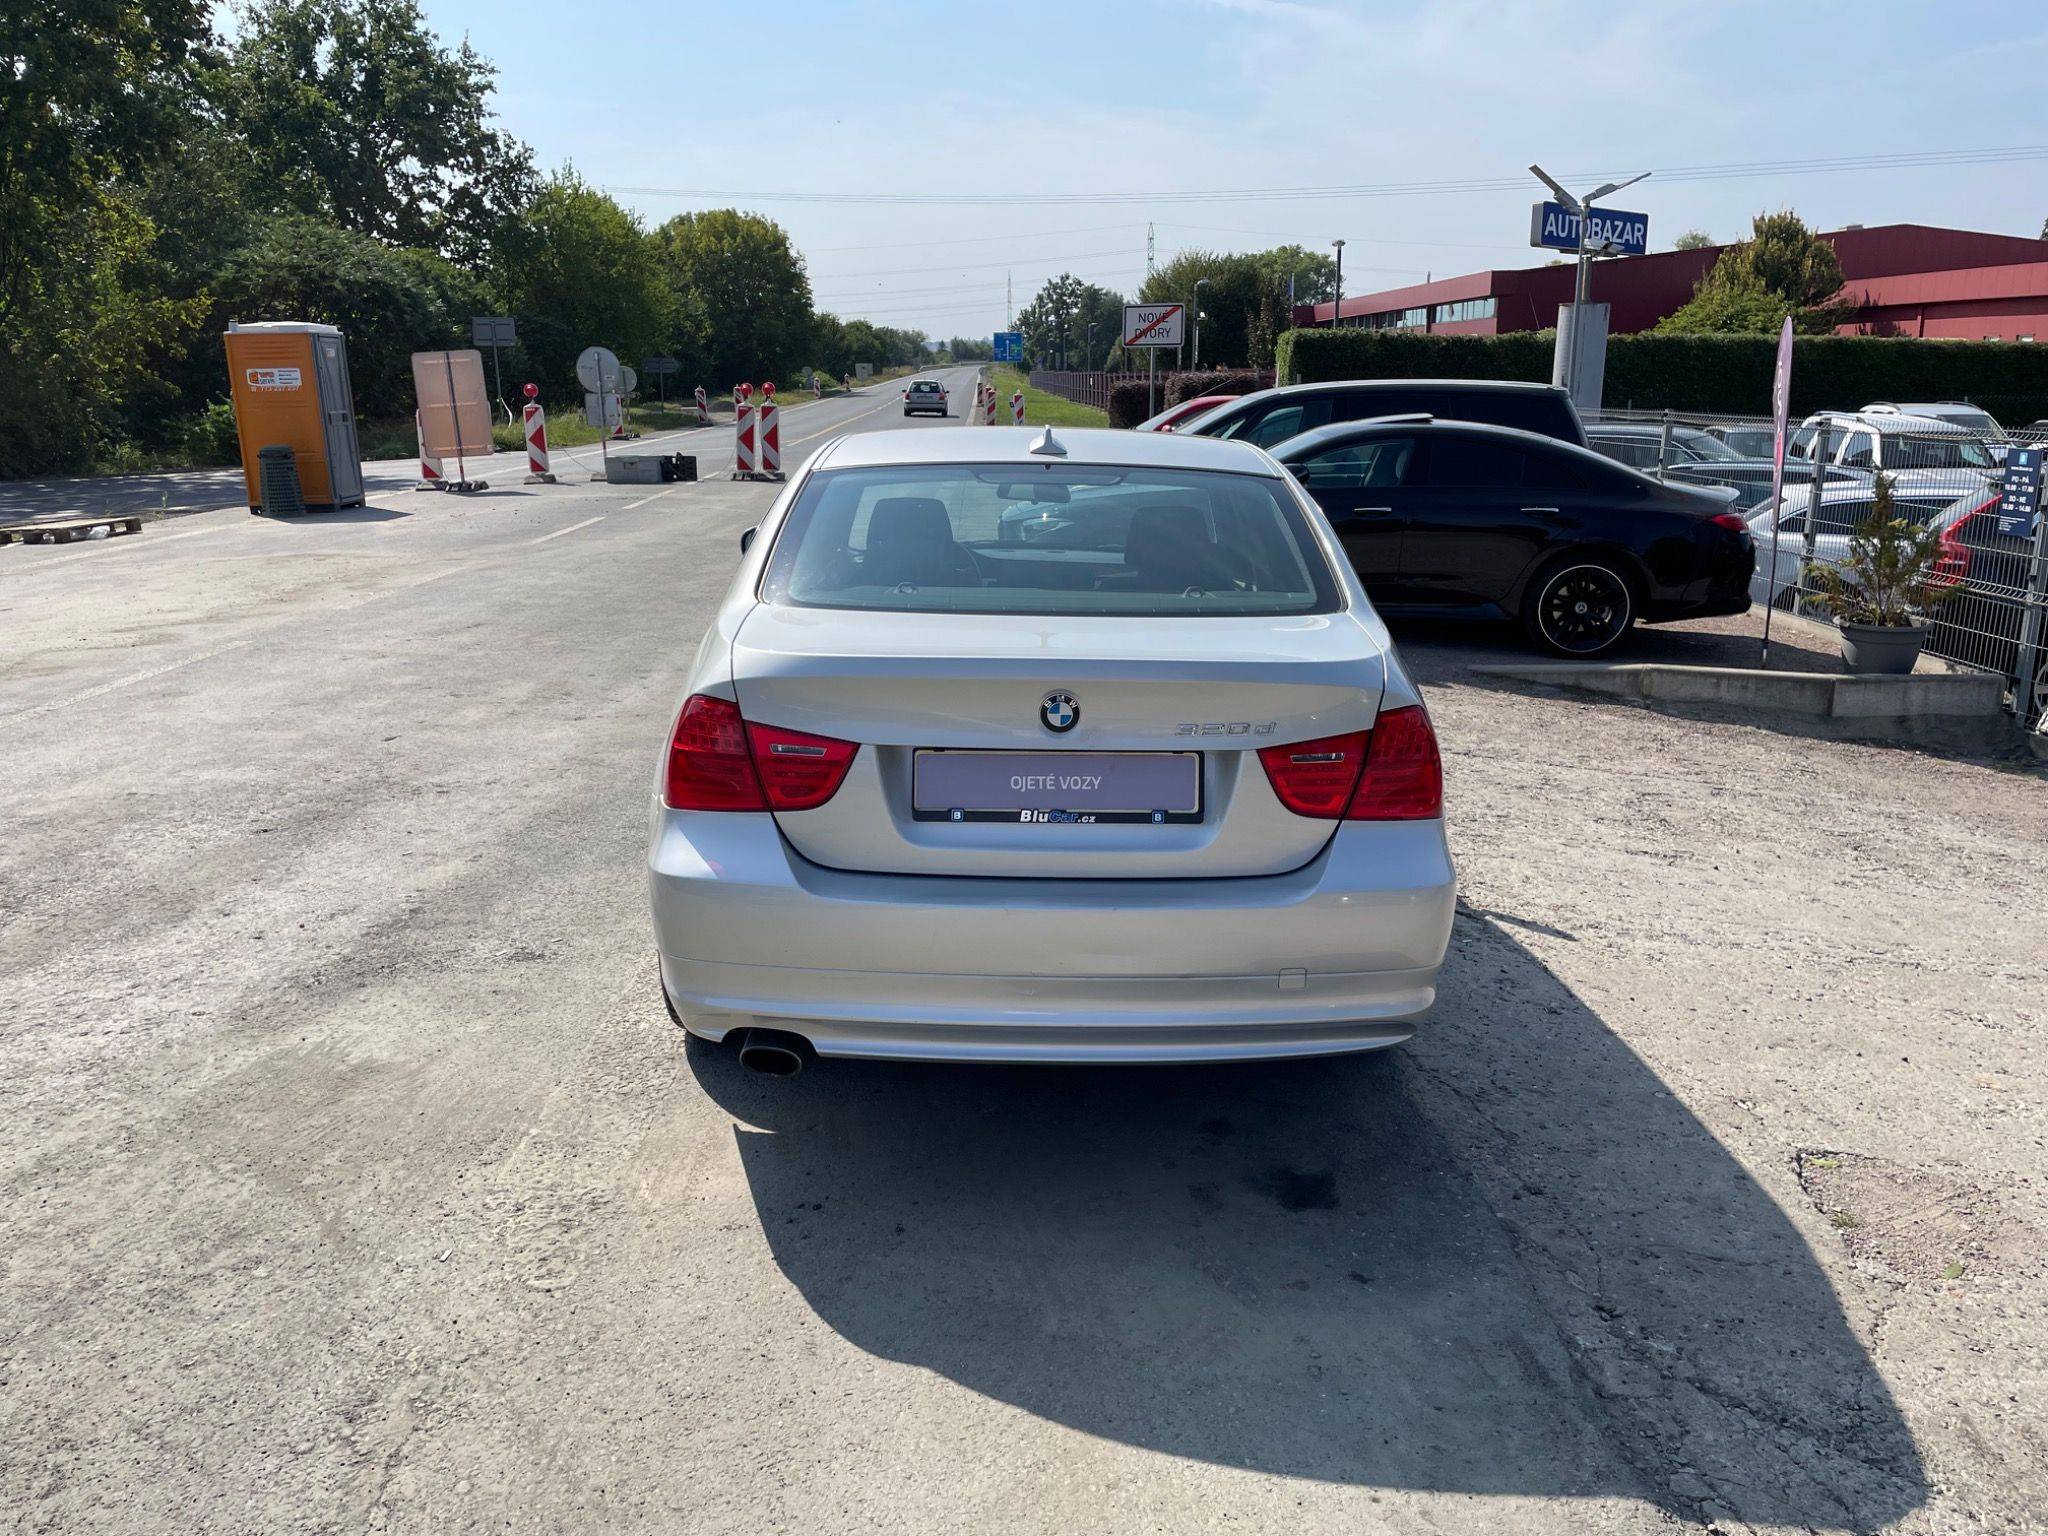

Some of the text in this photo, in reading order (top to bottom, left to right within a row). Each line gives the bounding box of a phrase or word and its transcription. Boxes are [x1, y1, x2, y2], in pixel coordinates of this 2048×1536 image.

[1545, 213, 1644, 245] AUTOBAZAR
[1138, 309, 1169, 323] NOVÉ
[1135, 327, 1172, 339] DVORY
[1044, 695, 1079, 709] BMW
[1175, 722, 1278, 737] 320d
[1010, 773, 1102, 792] OJETÉ VOZY
[1020, 809, 1096, 823] BluCar.cz
